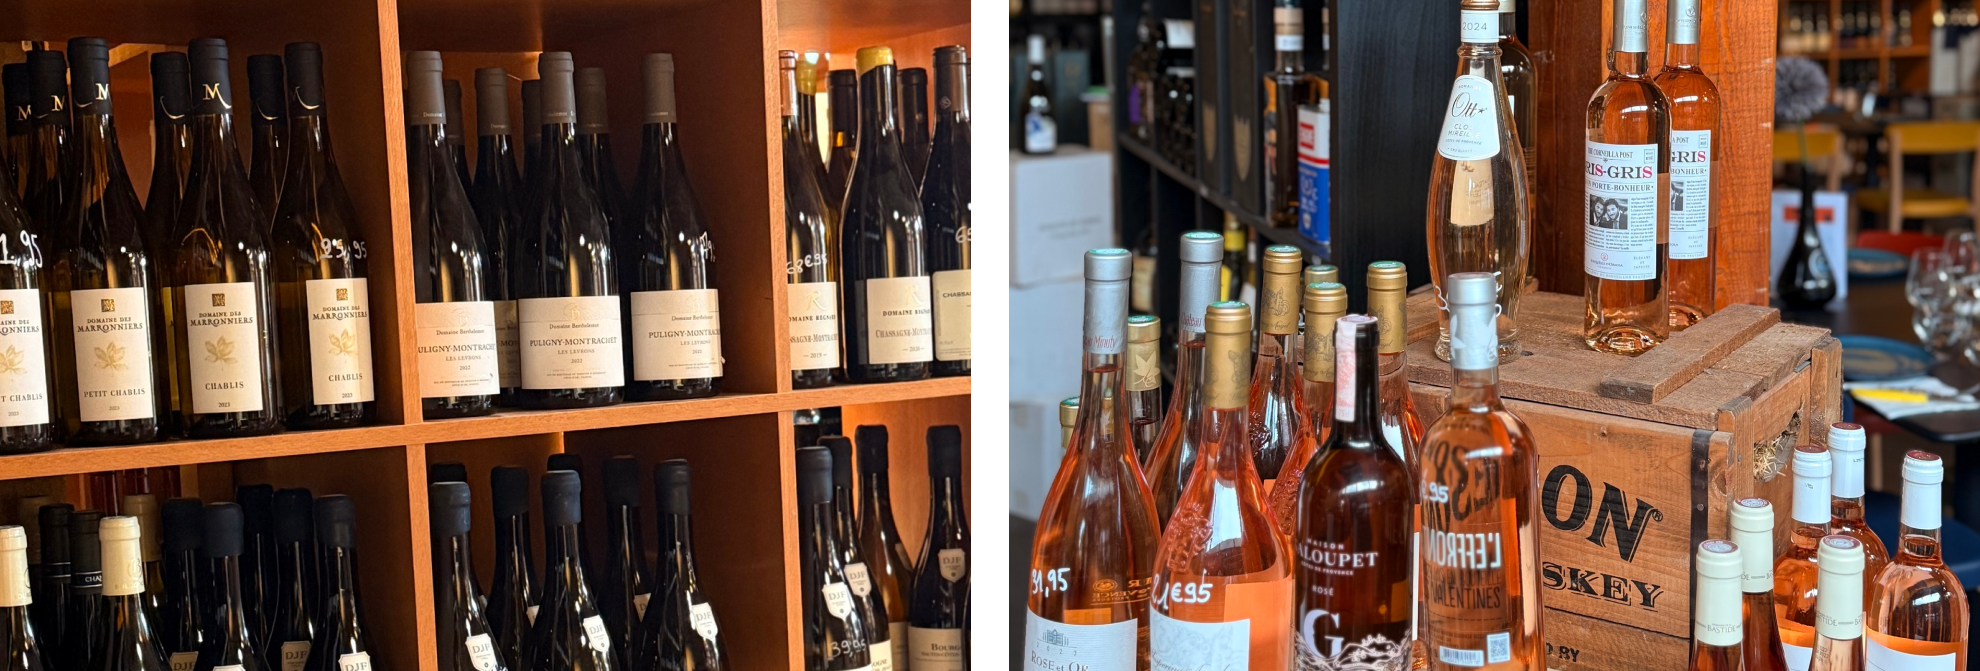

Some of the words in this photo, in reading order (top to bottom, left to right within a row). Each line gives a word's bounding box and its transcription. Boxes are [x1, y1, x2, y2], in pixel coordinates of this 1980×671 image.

[1463, 22, 1487, 31] 2024
[1452, 92, 1478, 118] Ott
[1620, 151, 1633, 159] POST
[312, 311, 367, 321] MARRONNIERS
[883, 309, 912, 317] DOMAINE
[190, 317, 253, 327] MARRONNIERS
[77, 323, 143, 333] MARRONNIERS
[530, 337, 617, 347] PULIGNY-MONTRACHET
[417, 343, 495, 353] ULIGNY-MONTRACHET
[328, 373, 363, 382] CHABLIS
[205, 381, 244, 390] CHABLIS
[9, 393, 43, 402] CHABLIS
[84, 390, 107, 398] PETIT
[110, 388, 146, 397] CHABLIS
[1307, 538, 1345, 550] MAISON
[943, 556, 962, 565] DJF
[850, 571, 866, 580] DJF
[1323, 568, 1354, 576] PROVENCE
[1312, 585, 1334, 596] ROSÉ
[1542, 561, 1664, 612] SKEY
[828, 590, 846, 600] DJF
[696, 611, 711, 622] DJF
[1707, 624, 1736, 634] BASTIDE
[472, 643, 490, 653] DJF
[1559, 644, 1580, 662] BY
[286, 650, 307, 660] DJF
